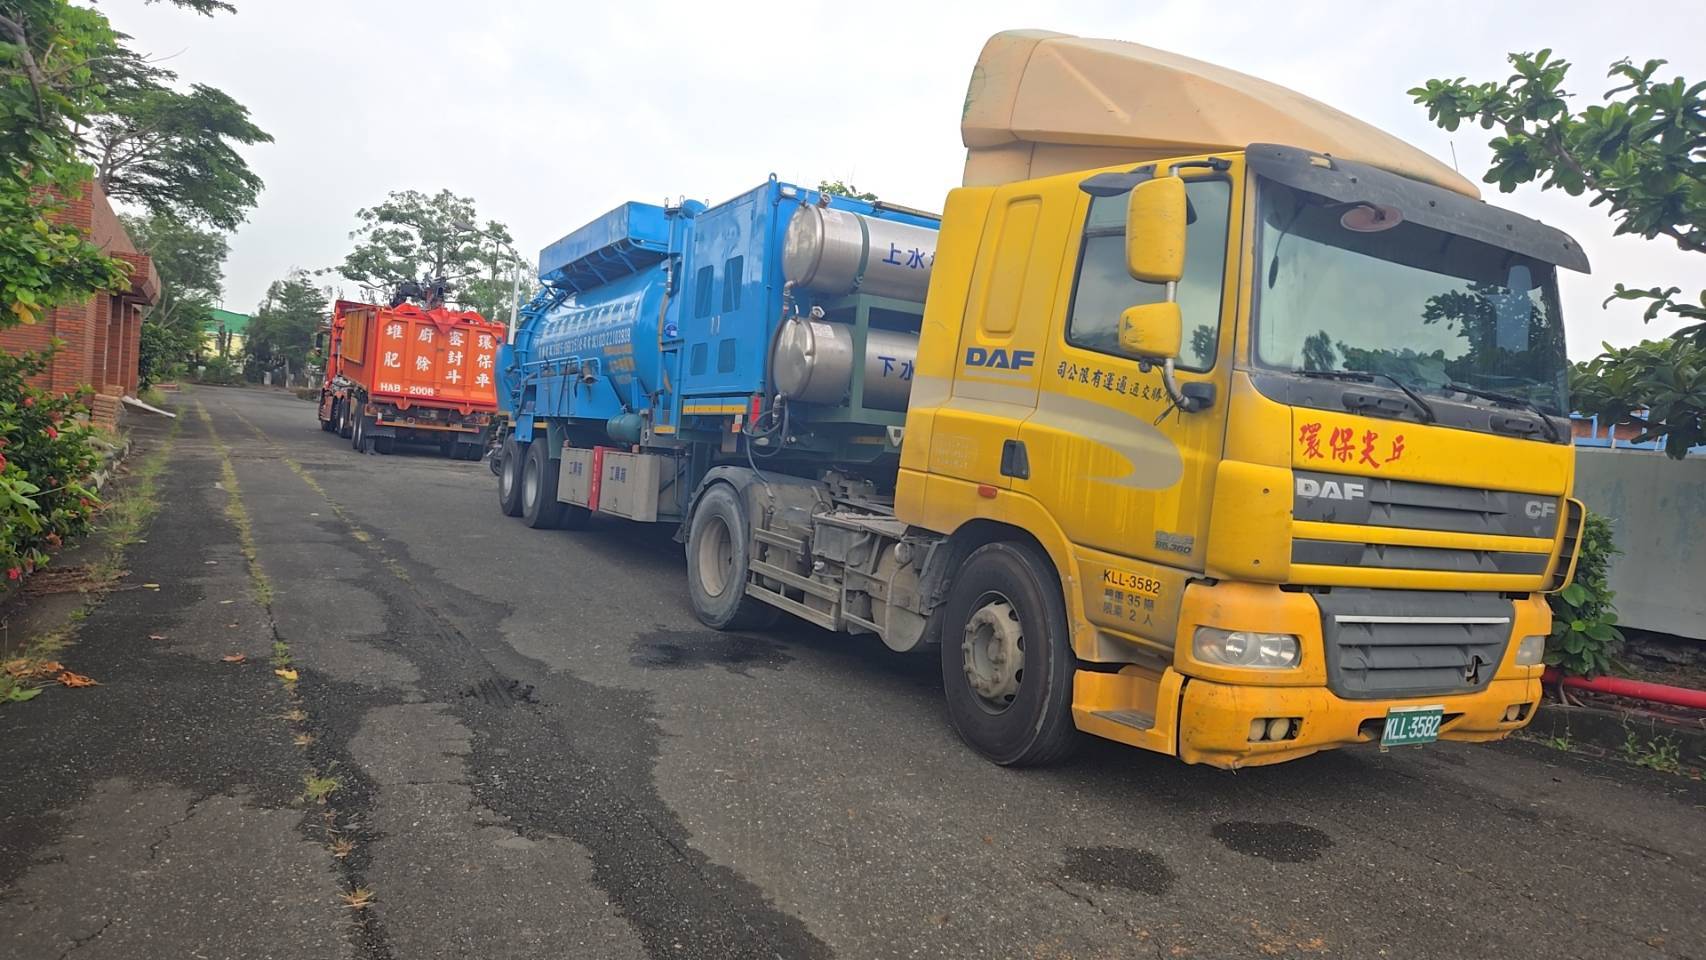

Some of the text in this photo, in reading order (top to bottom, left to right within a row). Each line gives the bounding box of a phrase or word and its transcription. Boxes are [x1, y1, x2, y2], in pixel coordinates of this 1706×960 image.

[882, 243, 936, 269] 上水
[965, 347, 1035, 370] DAF
[1296, 478, 1556, 519] DAF CF
[1103, 569, 1161, 594] KLL-3582
